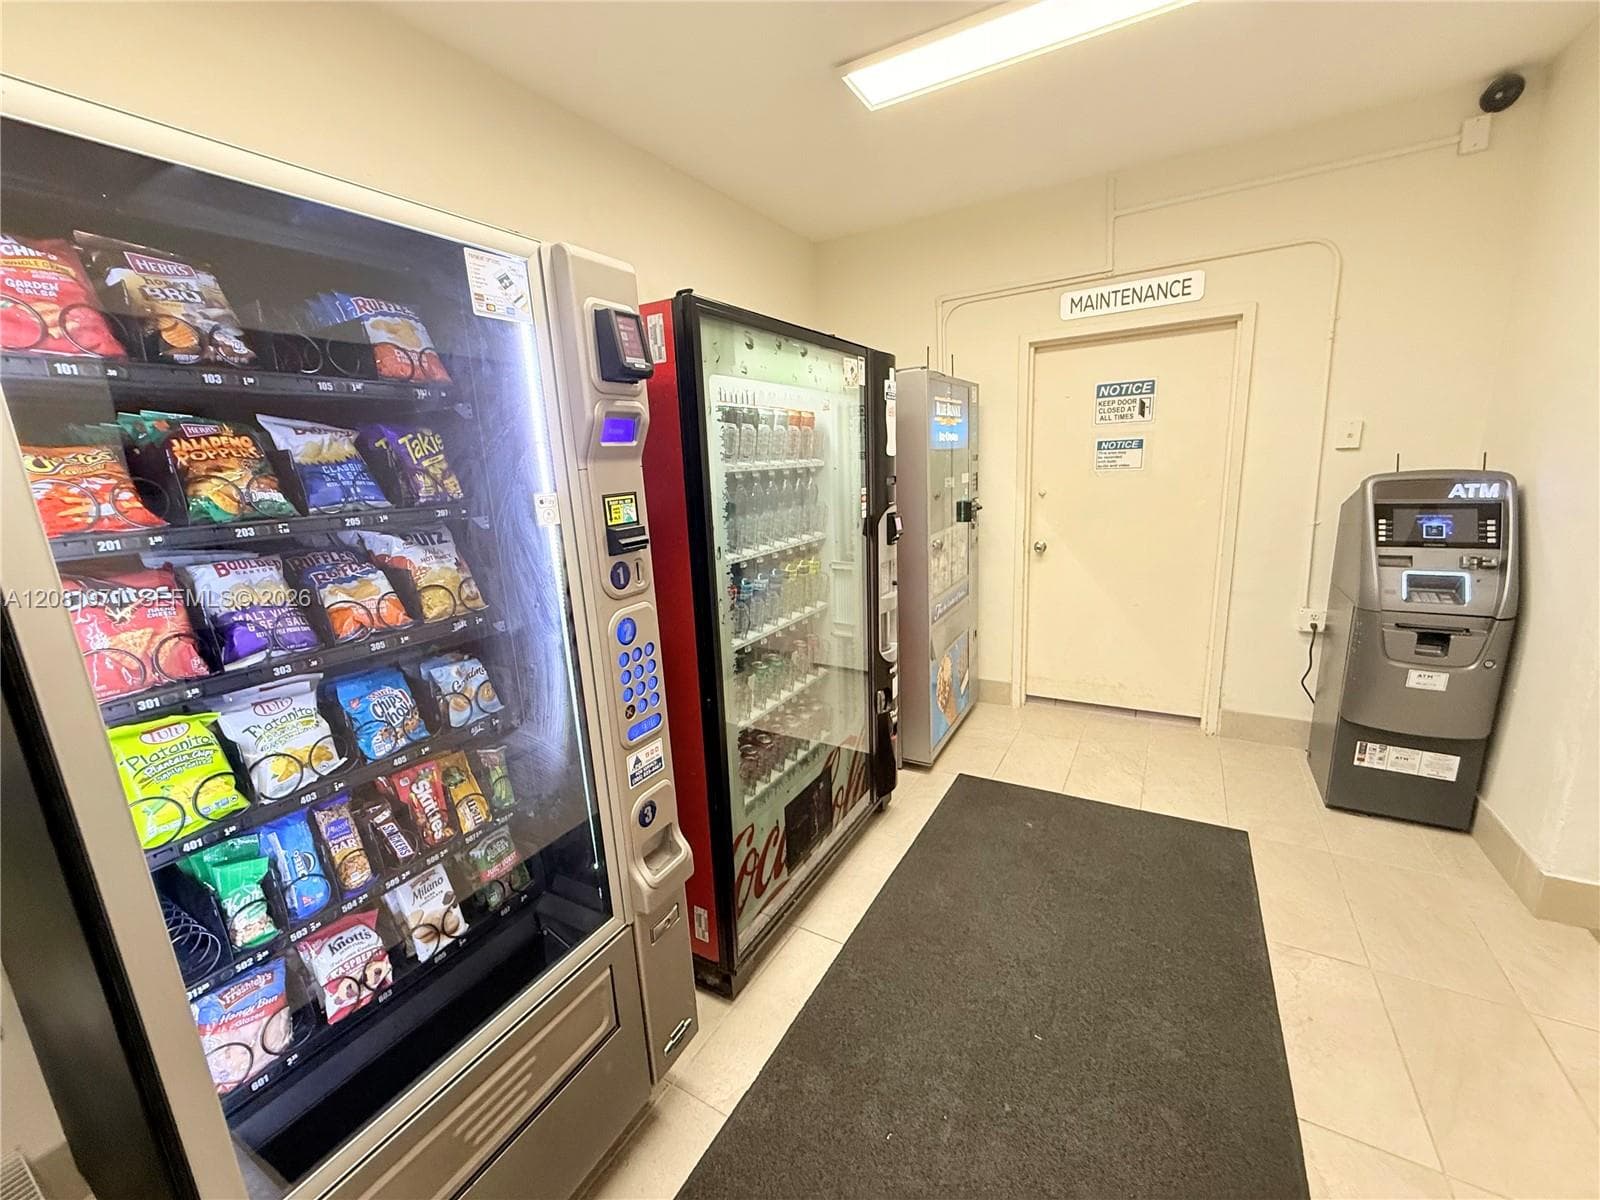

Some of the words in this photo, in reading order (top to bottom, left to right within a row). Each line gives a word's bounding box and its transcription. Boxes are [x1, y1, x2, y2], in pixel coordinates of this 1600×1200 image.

[135, 259, 190, 277] HERR'S
[5, 277, 60, 291] GARDEN
[16, 287, 58, 298] SALSA
[1070, 277, 1193, 314] MAINTENANCE
[351, 296, 420, 320] RUFFL
[54, 362, 79, 377] 101
[202, 373, 222, 385] 103
[317, 381, 334, 392] 105
[1099, 381, 1153, 398] NOTICE
[1098, 406, 1126, 414] CLOSED
[1127, 405, 1137, 413] AT
[1117, 398, 1137, 406] DOOR
[1099, 414, 1112, 422] ALL
[1114, 413, 1134, 421] TIMES
[1100, 440, 1140, 449] NOTICE
[1448, 482, 1500, 499] ATM
[345, 517, 361, 527] 205
[235, 527, 255, 538] 203
[97, 539, 122, 552] 201
[311, 561, 376, 586] RUFFL
[615, 566, 625, 585] 1
[63, 585, 174, 613] Doritos
[146, 611, 177, 619] CHEESE
[232, 610, 267, 623] MALT
[285, 615, 310, 628] SALT
[370, 641, 386, 652] 305
[273, 665, 292, 677] 303
[137, 698, 161, 712] 301
[371, 694, 404, 721] Chips
[242, 706, 319, 739] Platanito
[121, 733, 219, 773] Platanito
[393, 756, 408, 767] 405
[301, 792, 317, 805] 403
[410, 779, 443, 841] Skittles
[644, 806, 654, 823] 3
[183, 837, 204, 852] 401
[330, 838, 358, 857] BAR
[412, 876, 444, 906] Milano
[342, 899, 358, 913] 504
[289, 925, 309, 943] 503
[327, 927, 373, 957] Knott's
[234, 958, 254, 973] 502
[330, 947, 382, 979] RASPBER
[217, 1004, 258, 1027] Honey
[257, 993, 279, 1010] Bun
[235, 1010, 266, 1028] Glazed
[250, 1074, 269, 1091] 601
